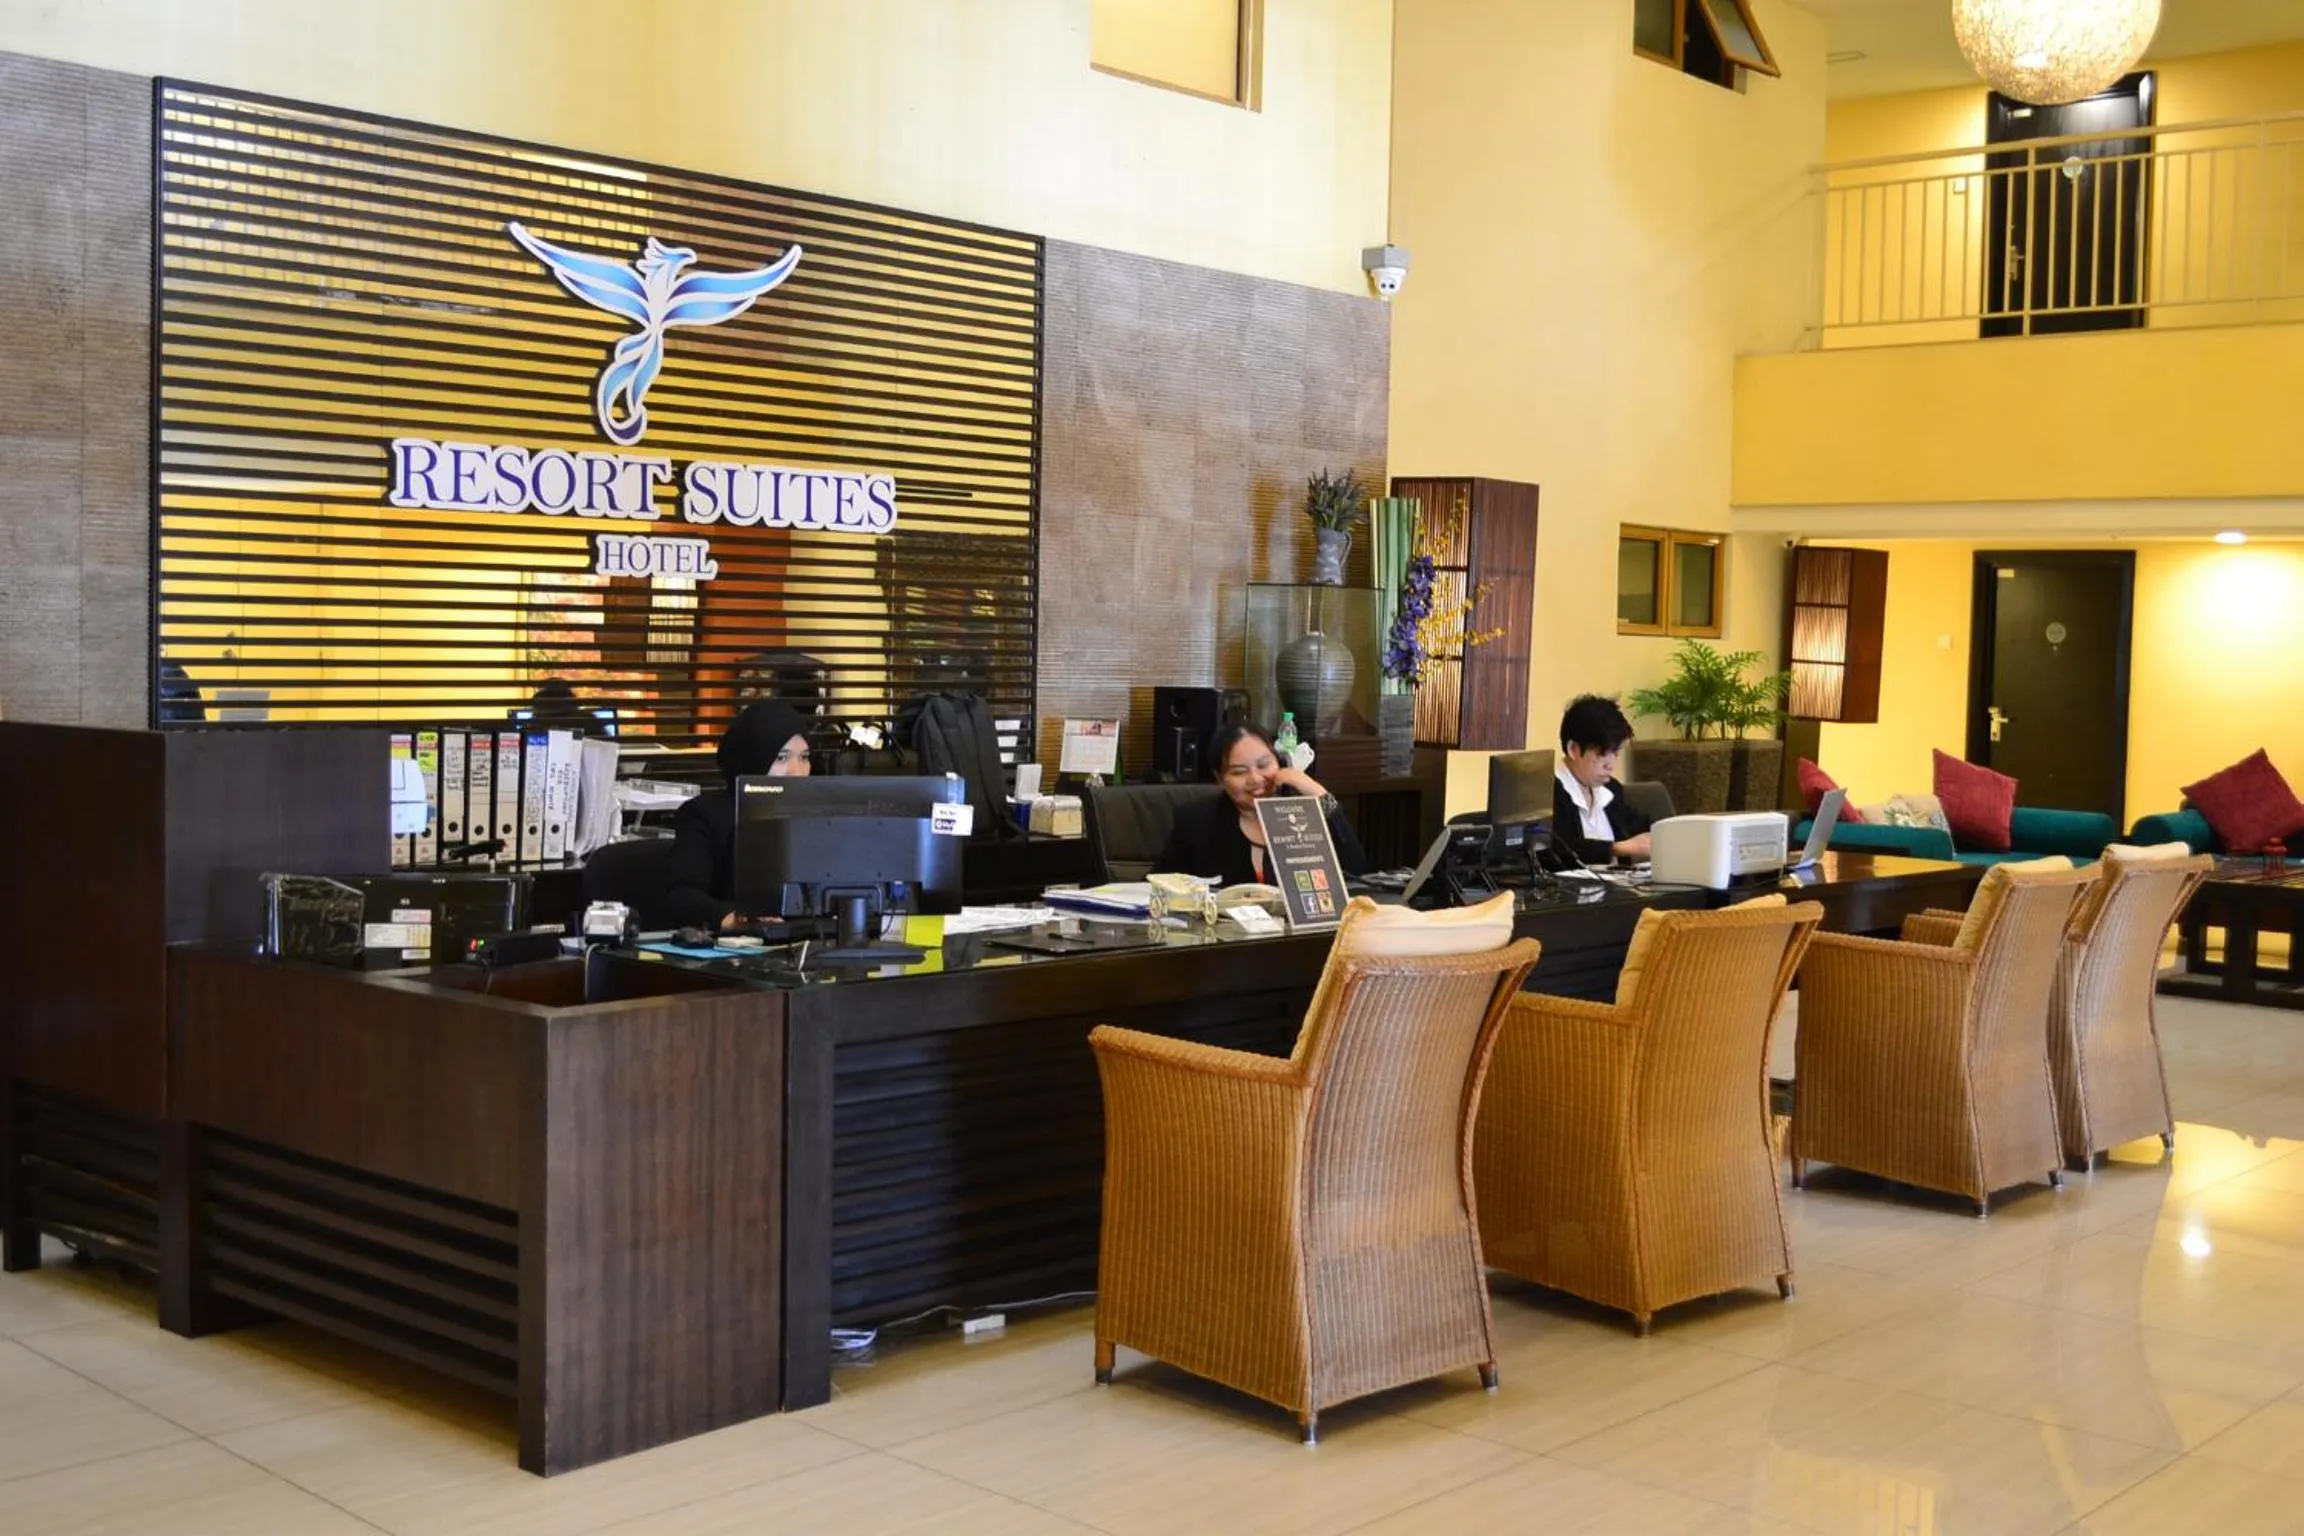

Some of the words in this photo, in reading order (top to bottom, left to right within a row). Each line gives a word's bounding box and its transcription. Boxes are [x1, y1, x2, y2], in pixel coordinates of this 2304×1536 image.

[397, 445, 666, 514] RESORT
[690, 466, 894, 527] SUITES
[602, 541, 713, 575] HOTEL
